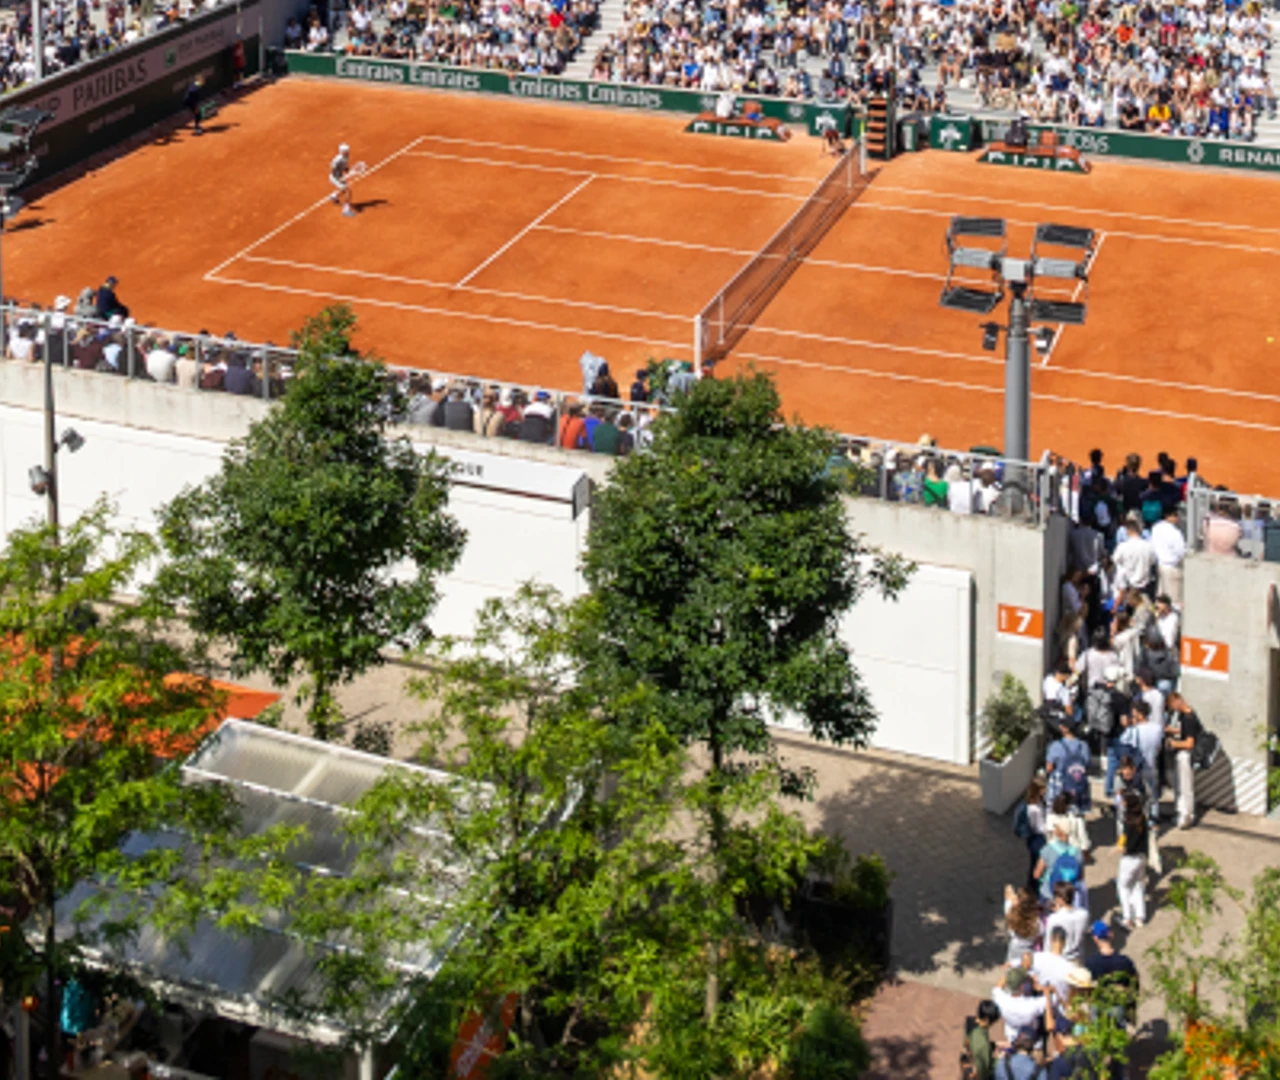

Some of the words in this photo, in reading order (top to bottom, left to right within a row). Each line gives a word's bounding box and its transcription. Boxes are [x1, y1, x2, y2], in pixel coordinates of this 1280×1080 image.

[72, 57, 148, 110] PARIBAS
[335, 57, 404, 82] Emirates
[409, 62, 480, 89] Emirates
[508, 77, 582, 99] Emirates
[588, 83, 661, 108] Emirates
[1015, 610, 1033, 633] 7
[1199, 643, 1218, 666] 7
